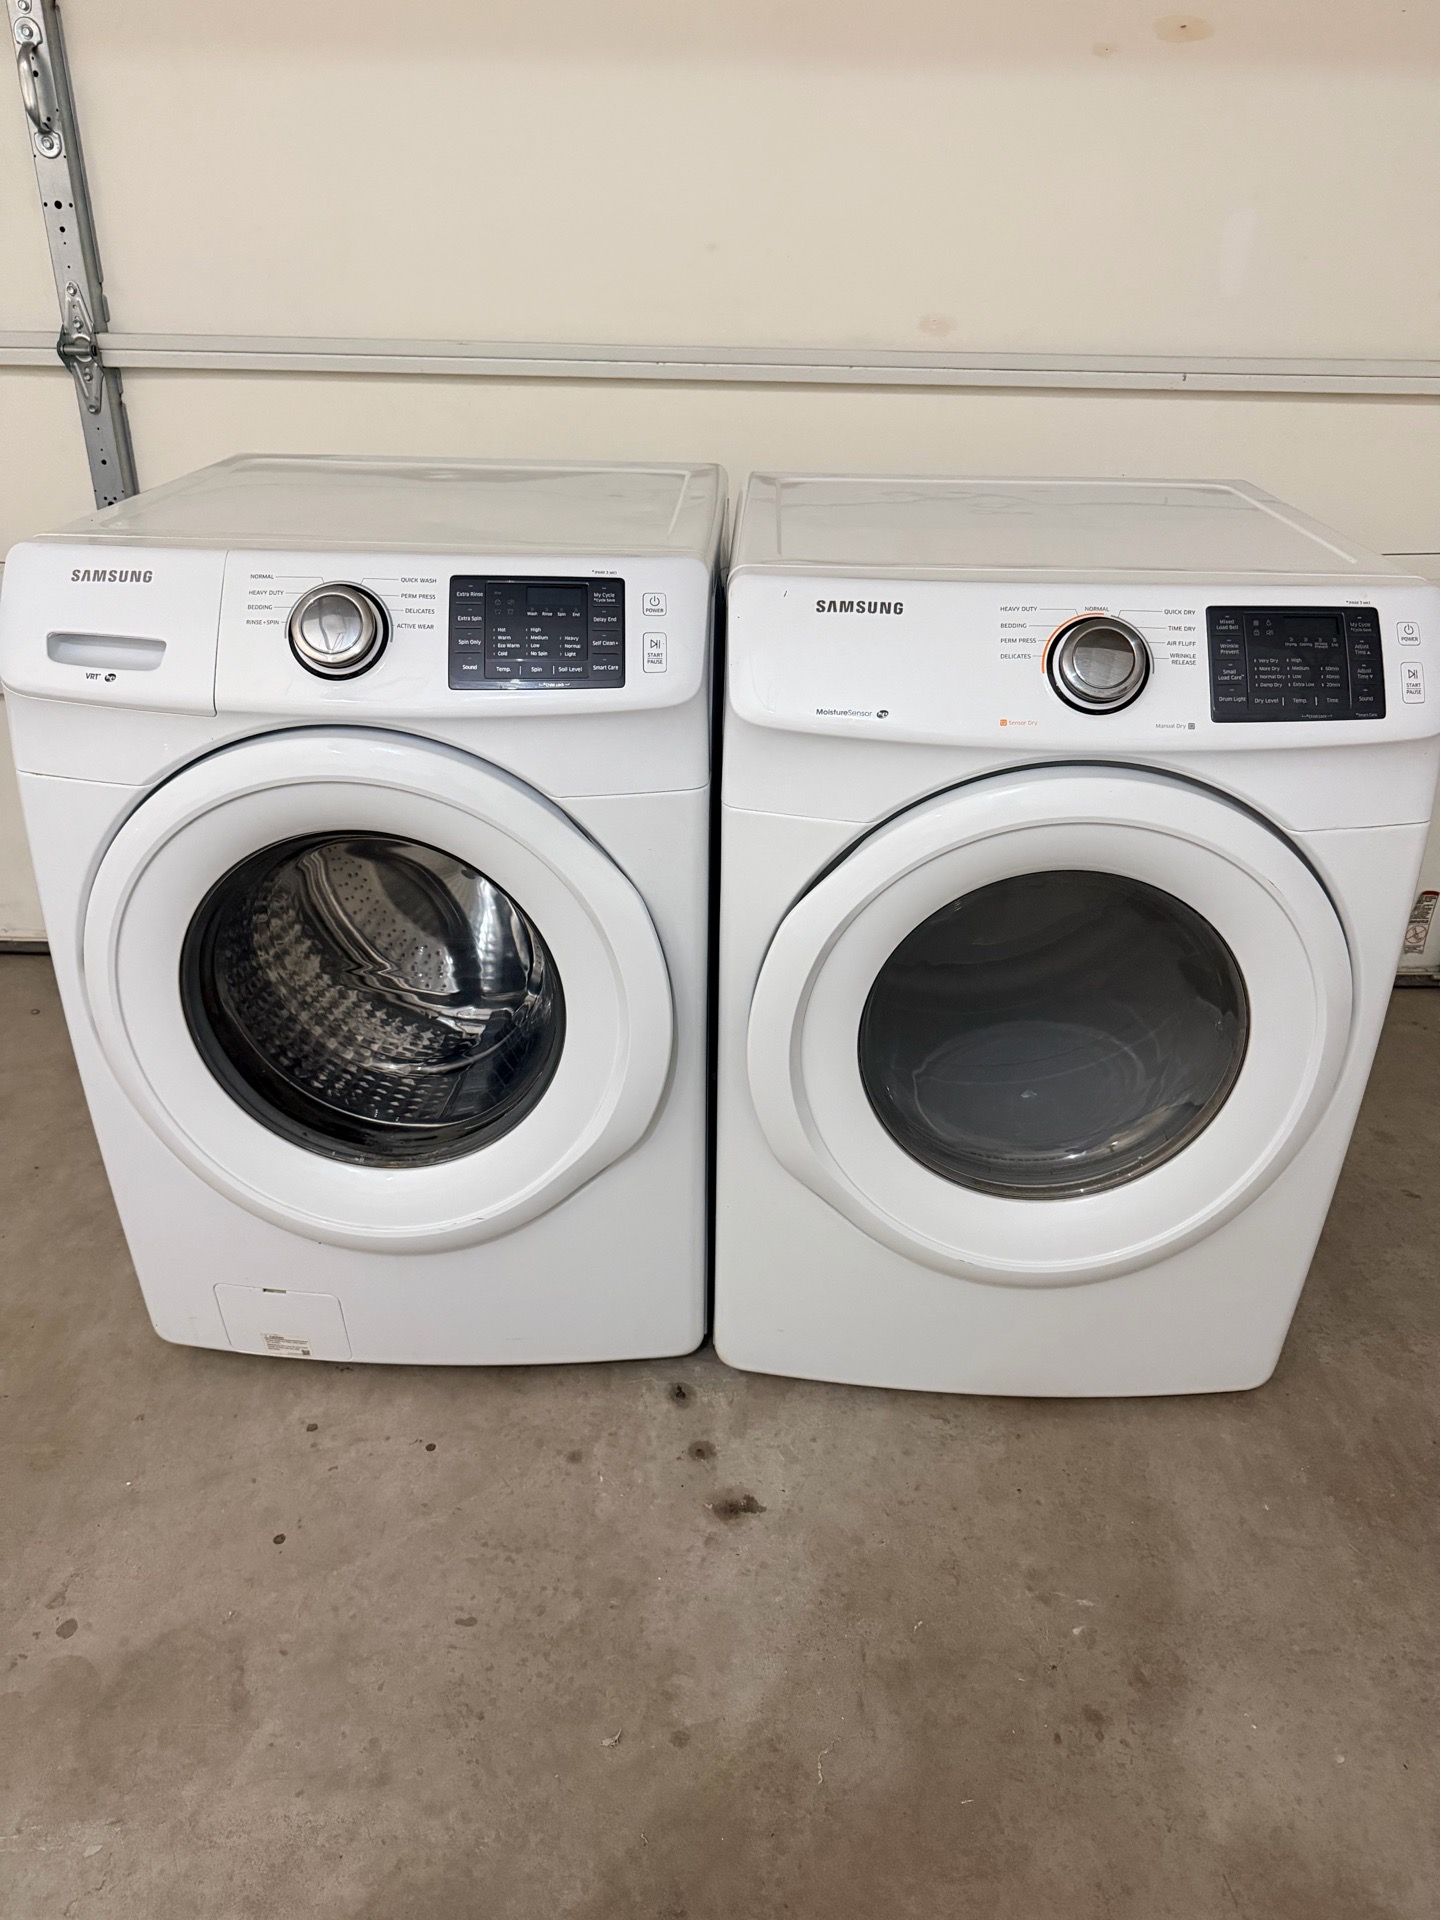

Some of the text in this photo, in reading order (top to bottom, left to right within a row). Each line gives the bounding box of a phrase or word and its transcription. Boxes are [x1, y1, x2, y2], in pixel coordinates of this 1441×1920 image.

[71, 569, 153, 583] SAMSUNG
[816, 600, 904, 615] SAMSUNG
[816, 708, 872, 717] MoistureSensor
